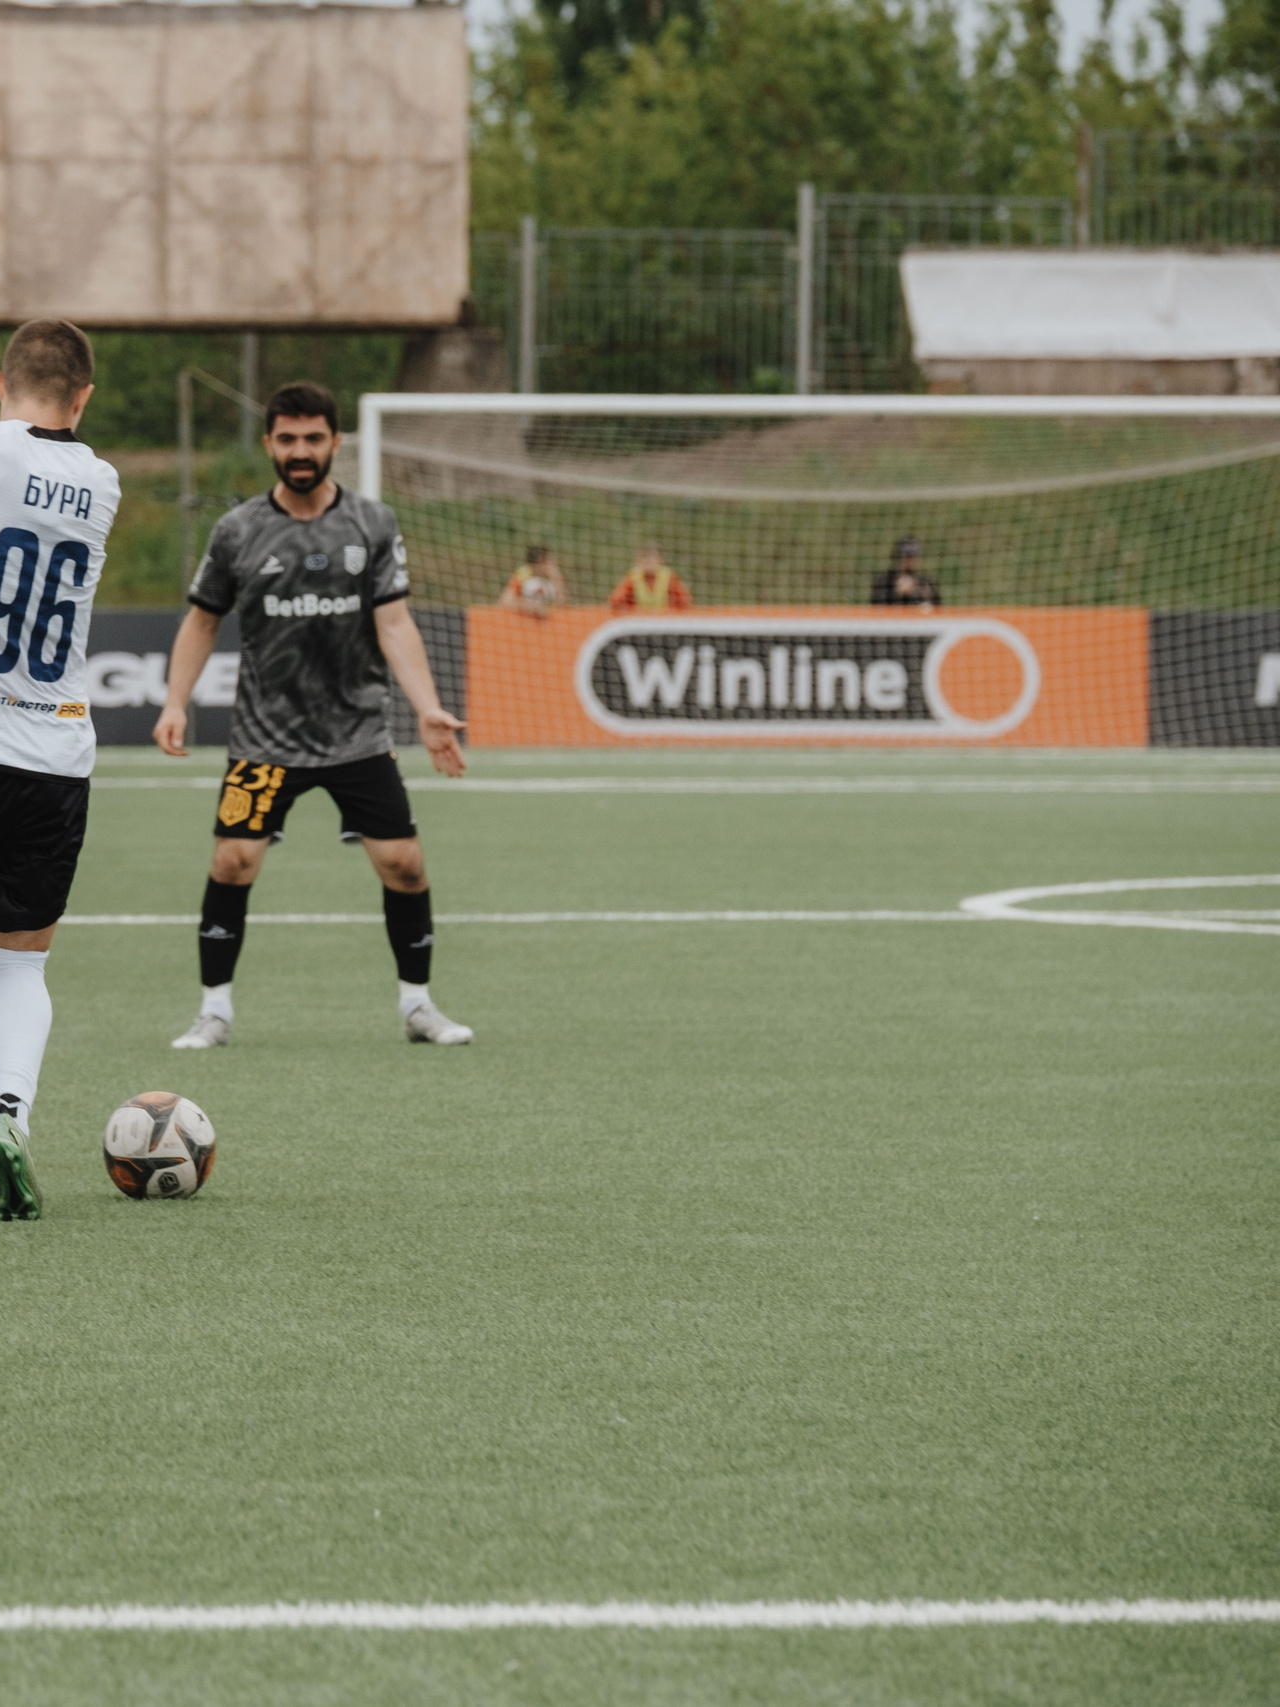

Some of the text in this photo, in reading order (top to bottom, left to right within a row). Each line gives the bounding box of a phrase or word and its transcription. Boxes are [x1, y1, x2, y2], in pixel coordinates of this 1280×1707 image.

[24, 474, 92, 520] БУРА
[263, 593, 361, 617] BetBoom
[617, 645, 909, 711] Winline
[60, 704, 86, 717] PRO
